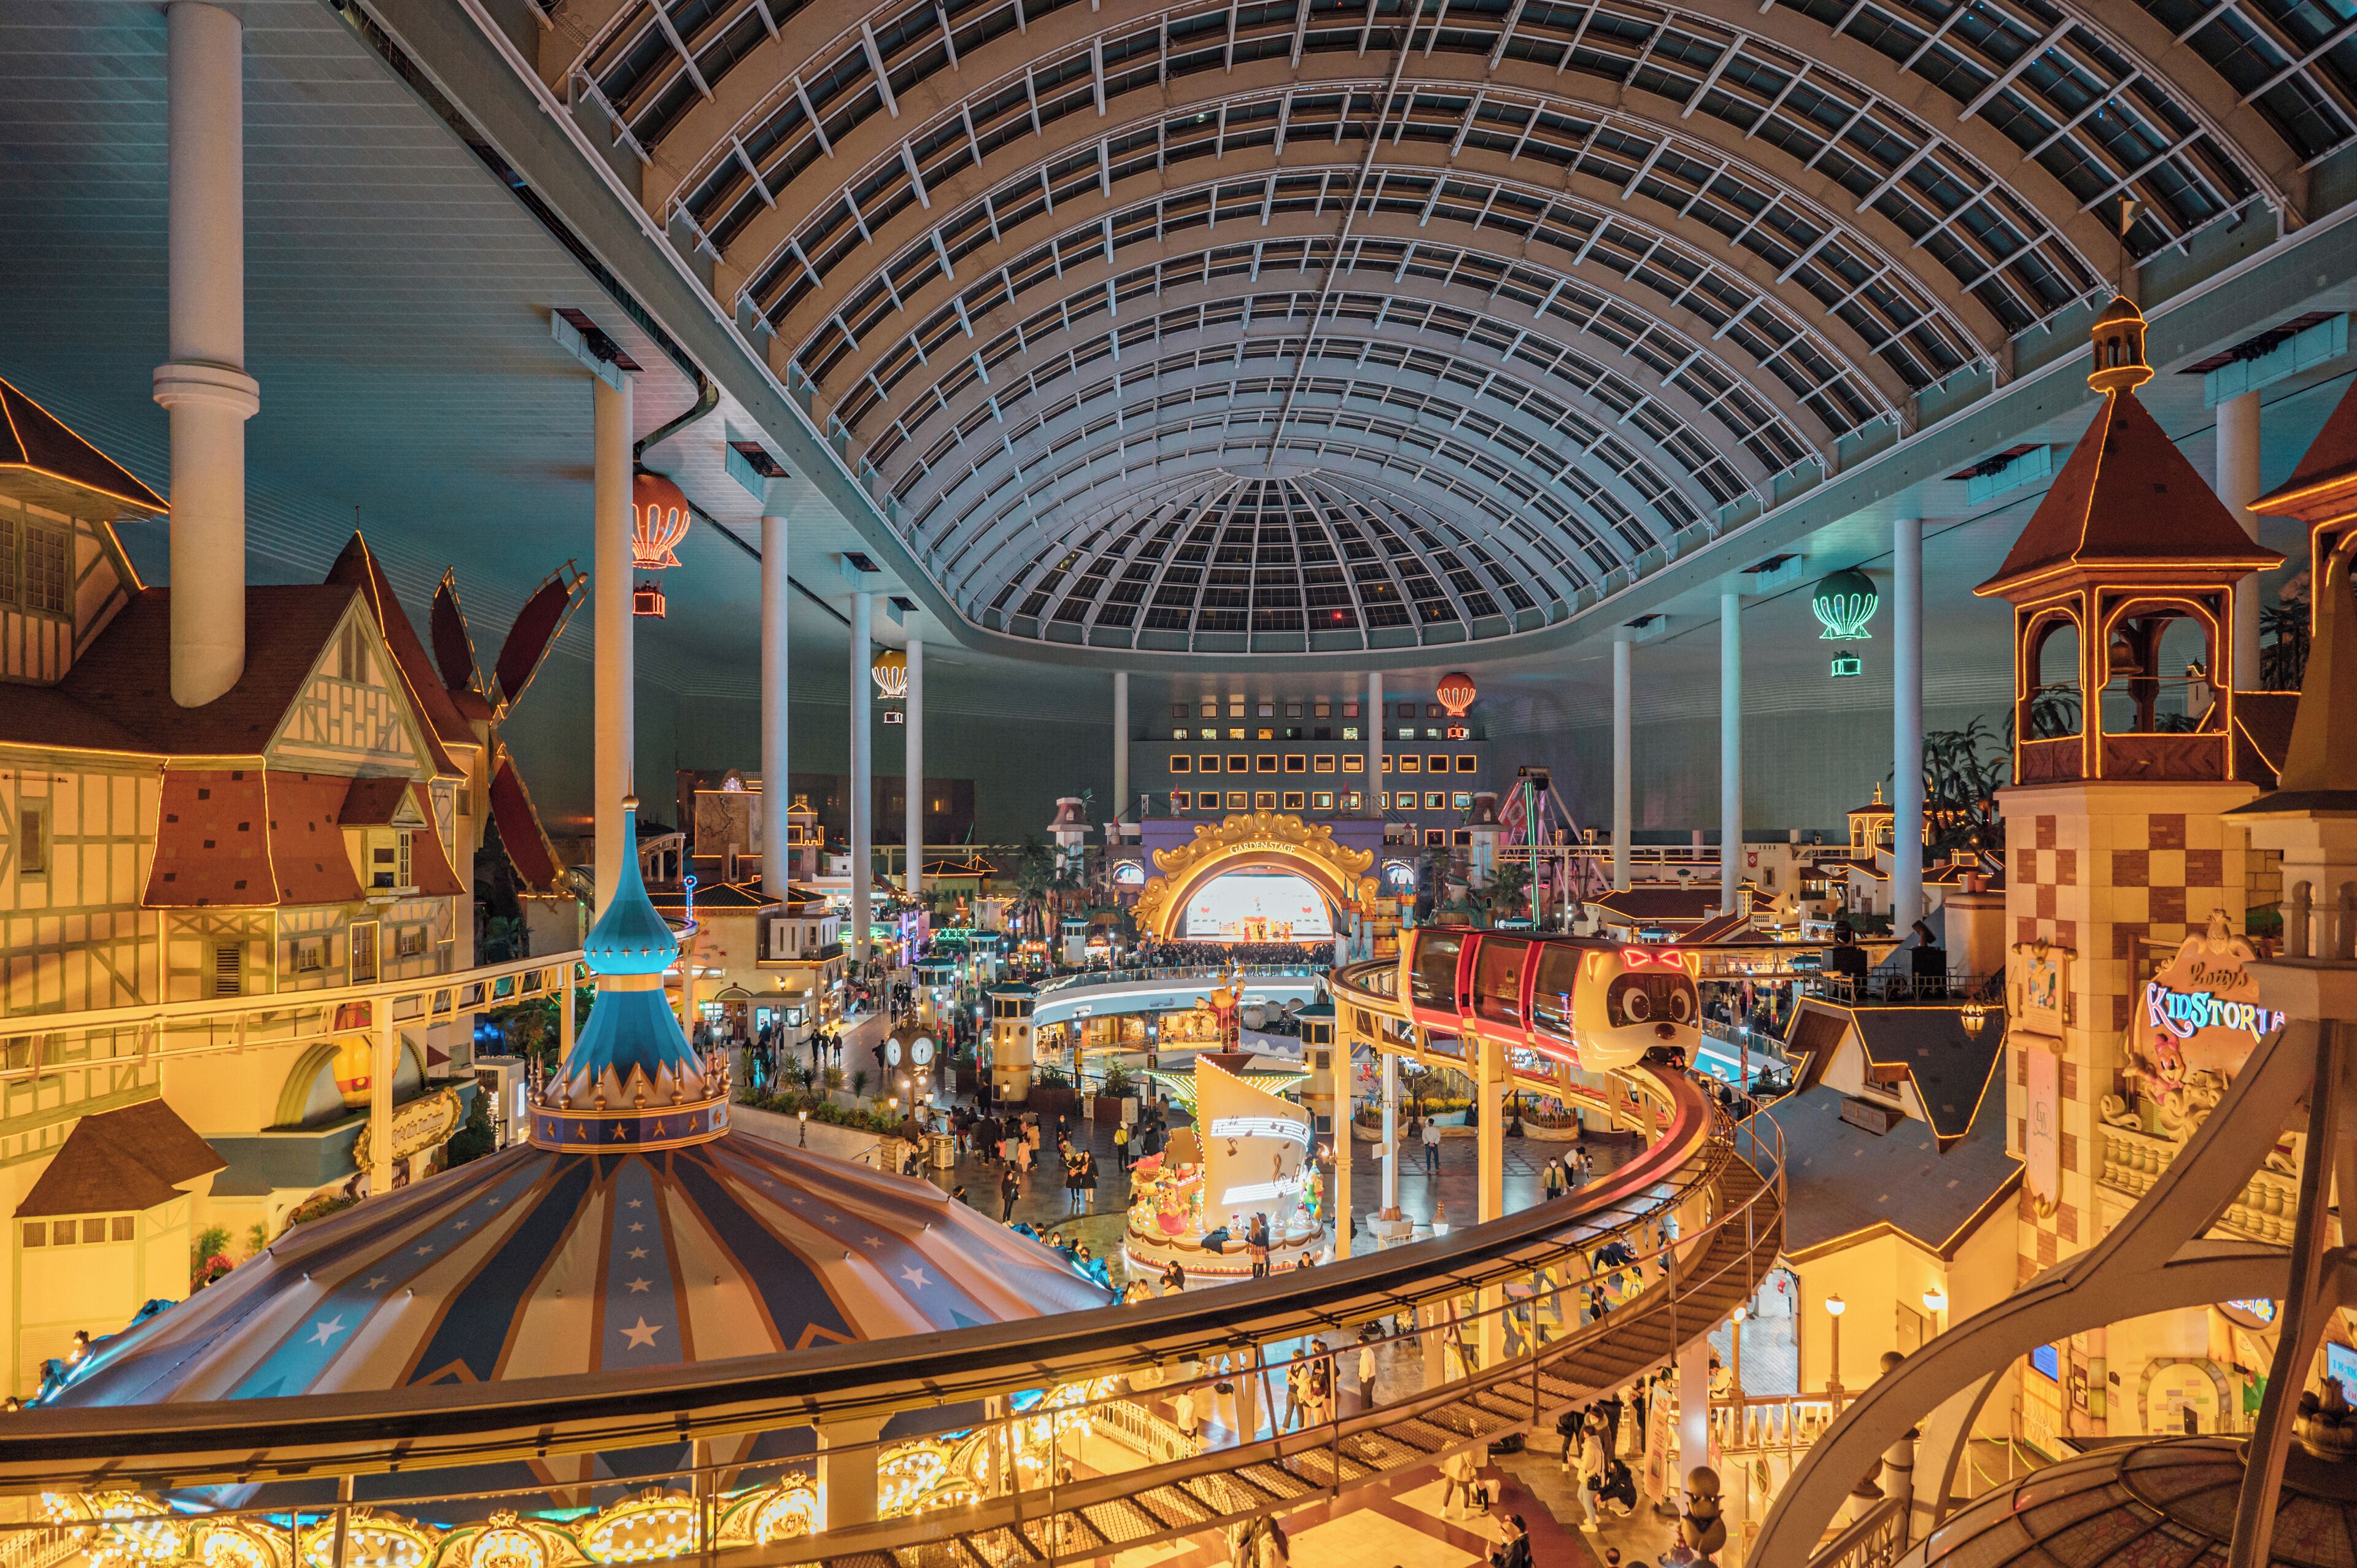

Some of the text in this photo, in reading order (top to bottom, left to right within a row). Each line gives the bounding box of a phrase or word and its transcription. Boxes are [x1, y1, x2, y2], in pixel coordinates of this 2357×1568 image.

[668, 554, 674, 564] 2
[1229, 841, 1296, 855] GARDEN STAGE
